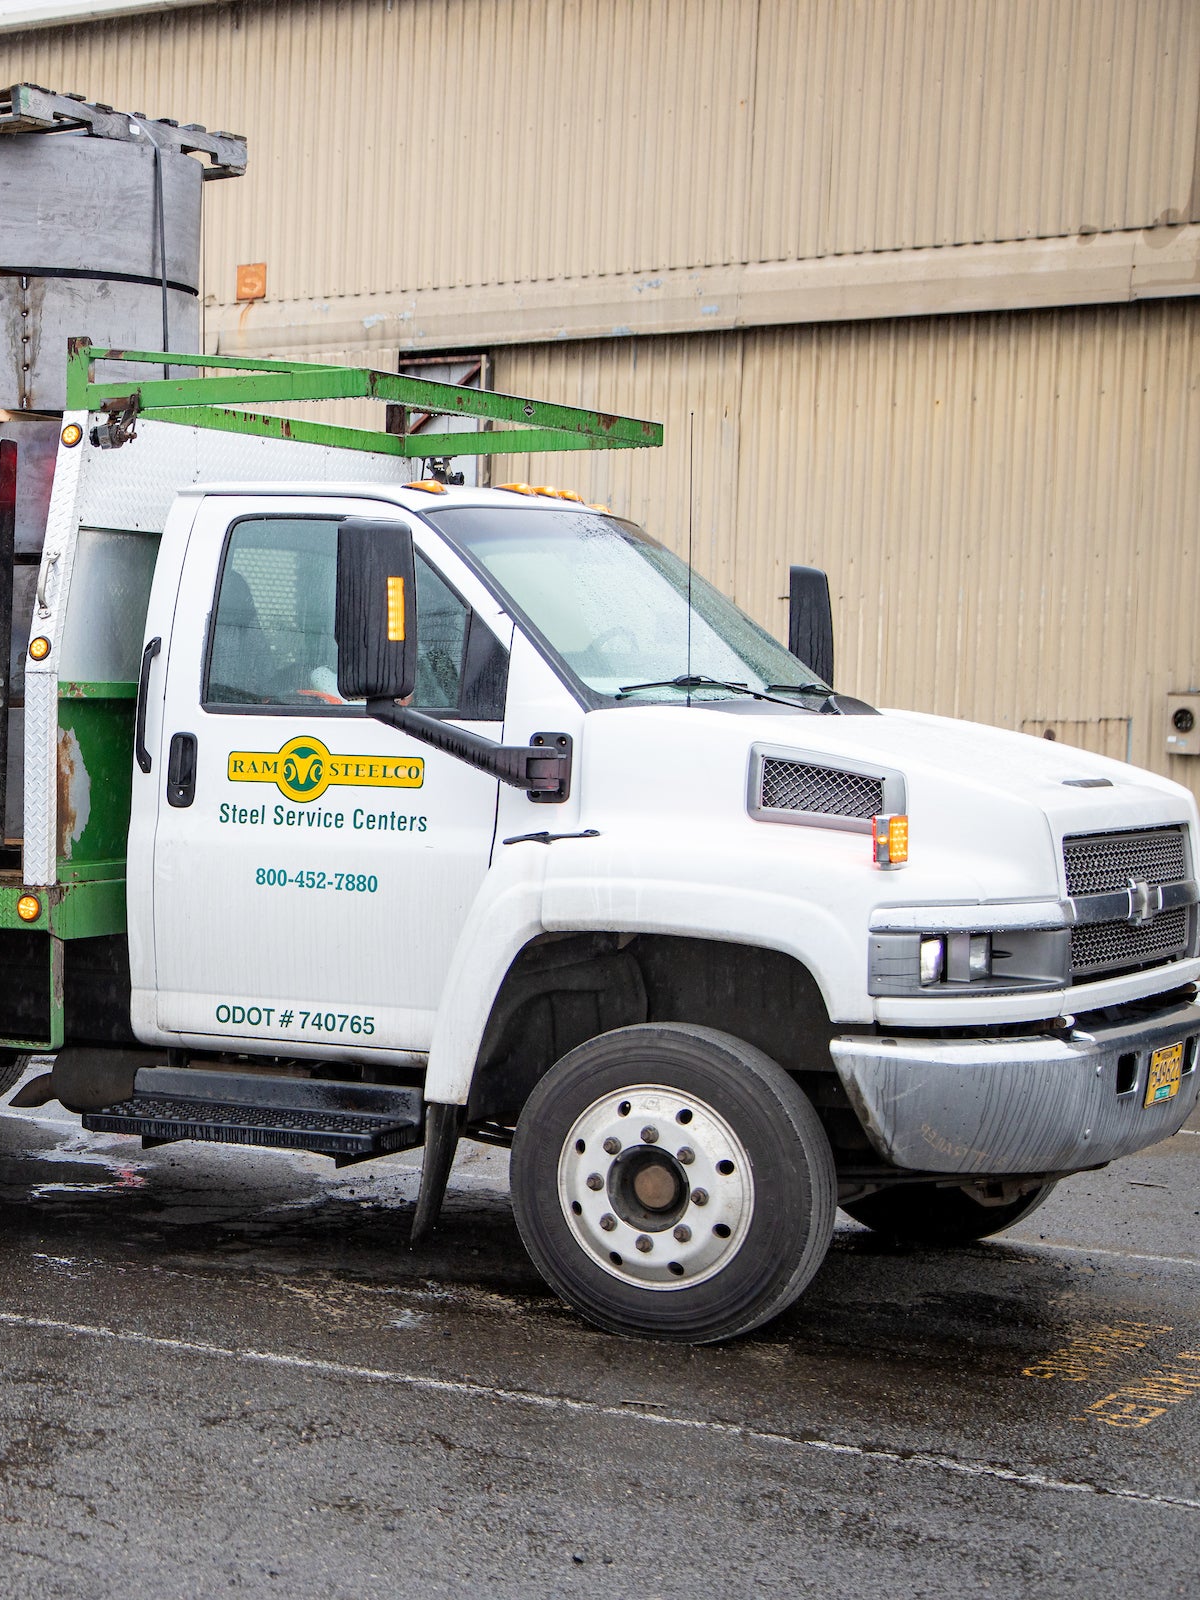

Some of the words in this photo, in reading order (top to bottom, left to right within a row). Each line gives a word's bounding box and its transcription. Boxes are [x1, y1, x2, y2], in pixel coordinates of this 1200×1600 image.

[233, 759, 279, 775] RAM
[329, 763, 421, 781] STEELCO
[219, 803, 266, 826] Steel
[273, 805, 345, 829] Service
[353, 808, 428, 833] Centers
[255, 867, 379, 893] 800-452-7880
[215, 1004, 275, 1026] ODOT
[298, 1010, 376, 1036] 740765
